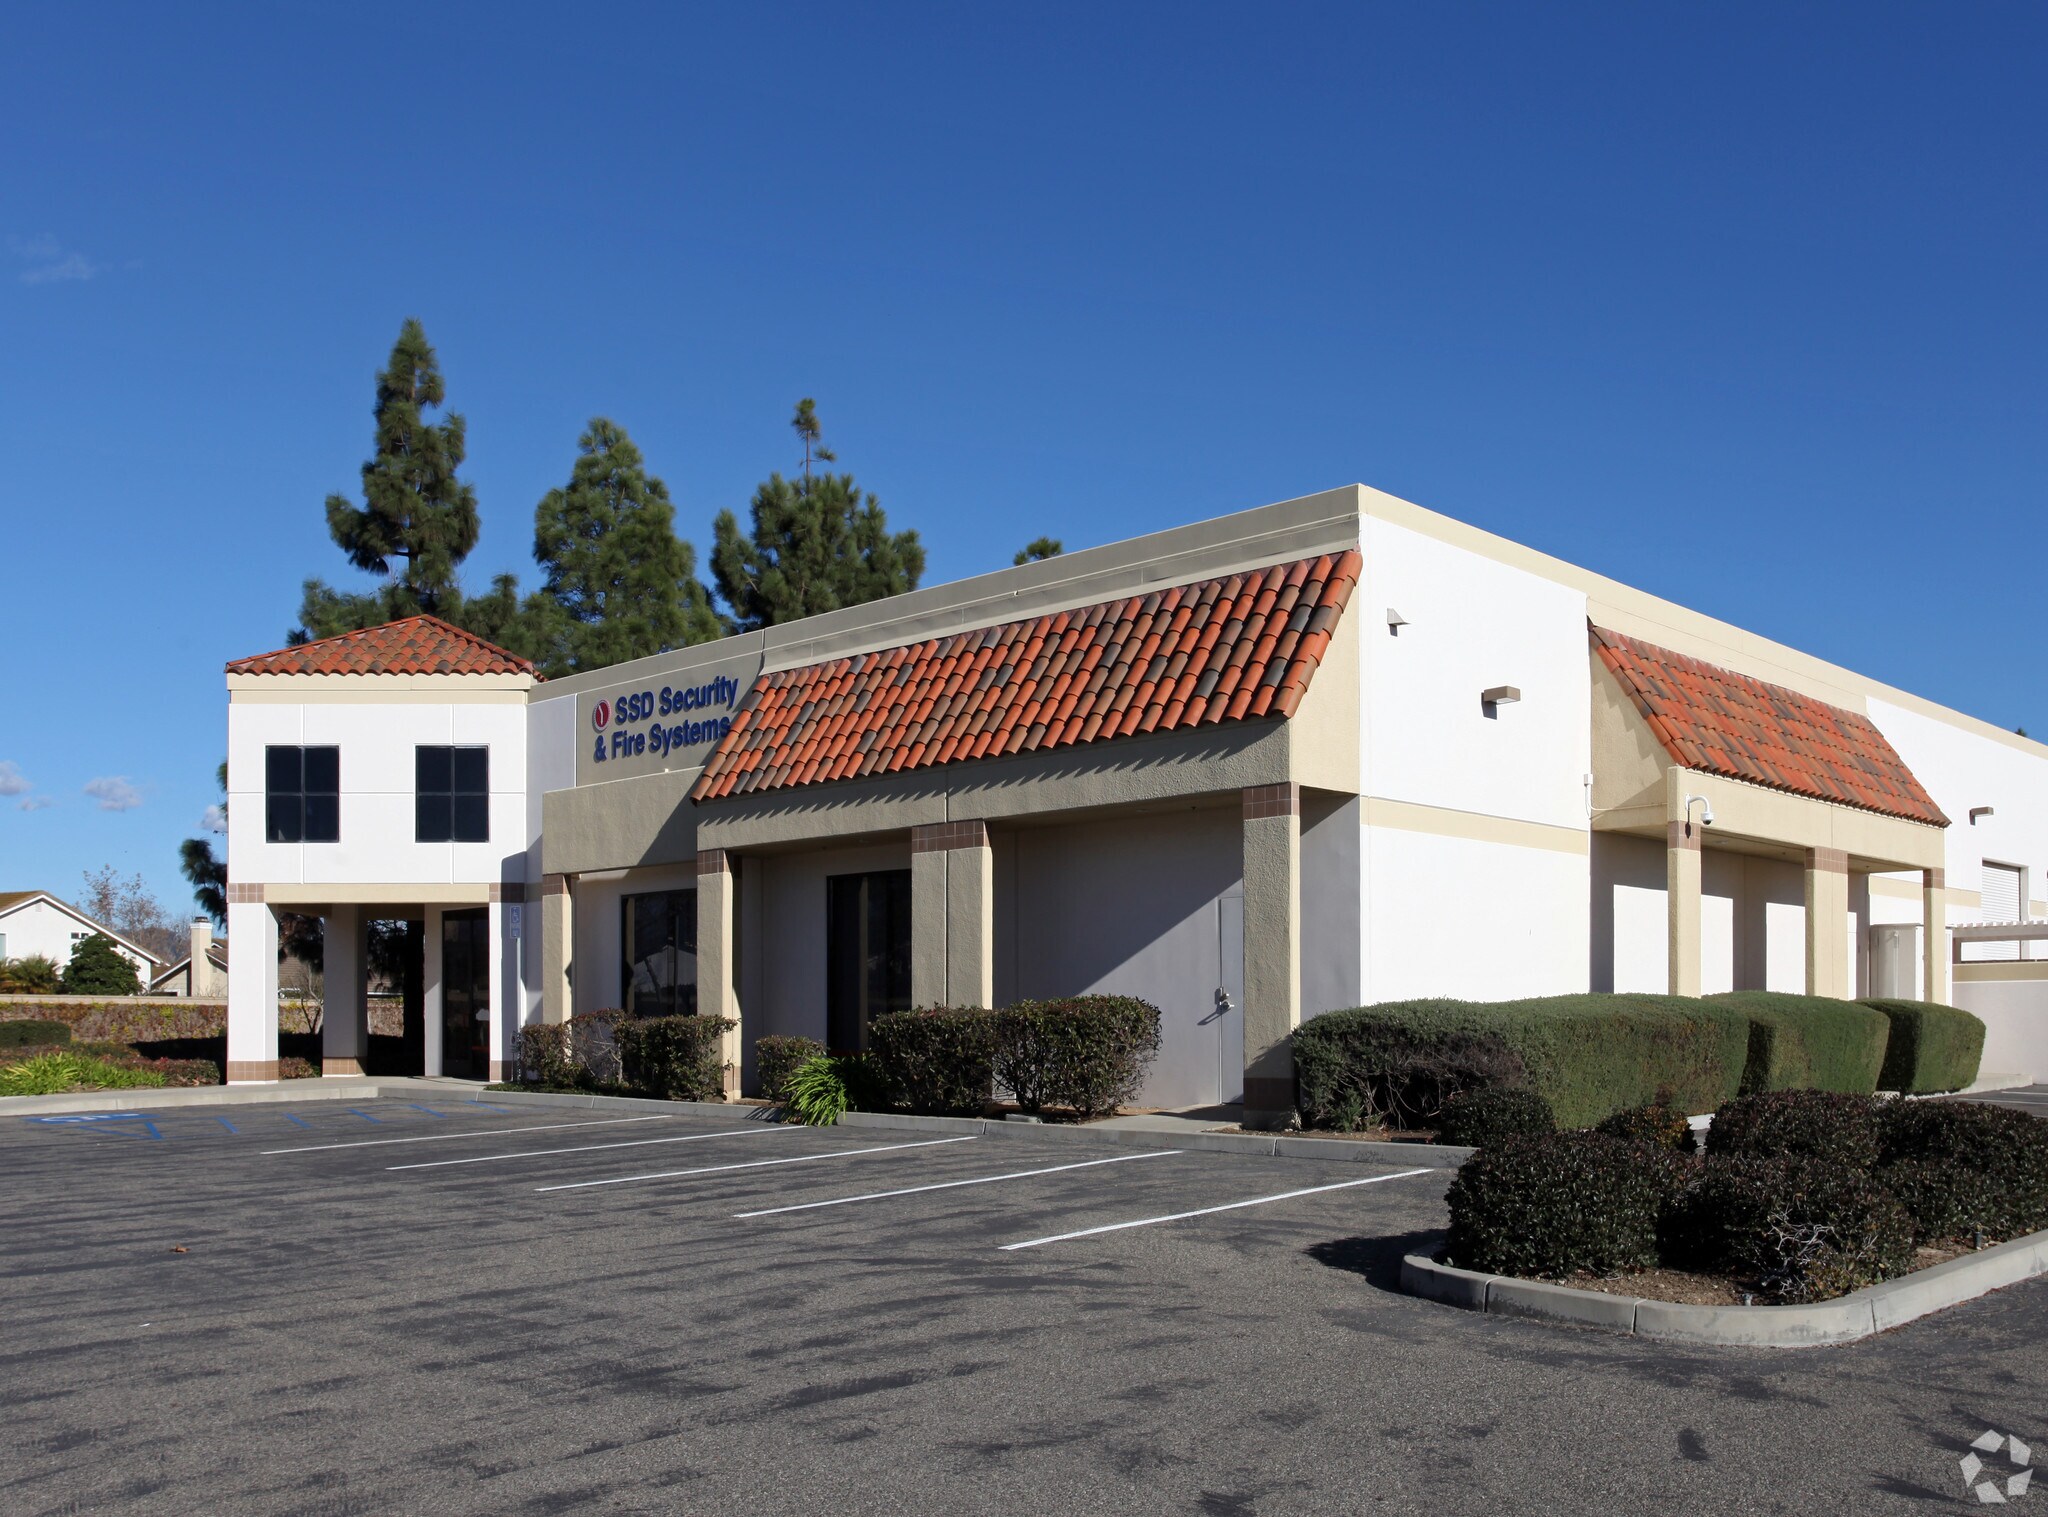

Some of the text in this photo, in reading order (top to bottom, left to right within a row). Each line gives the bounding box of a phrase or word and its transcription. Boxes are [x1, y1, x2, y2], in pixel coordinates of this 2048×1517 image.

[615, 676, 739, 724] SSD Security
[594, 716, 731, 761] & Fire Systems
